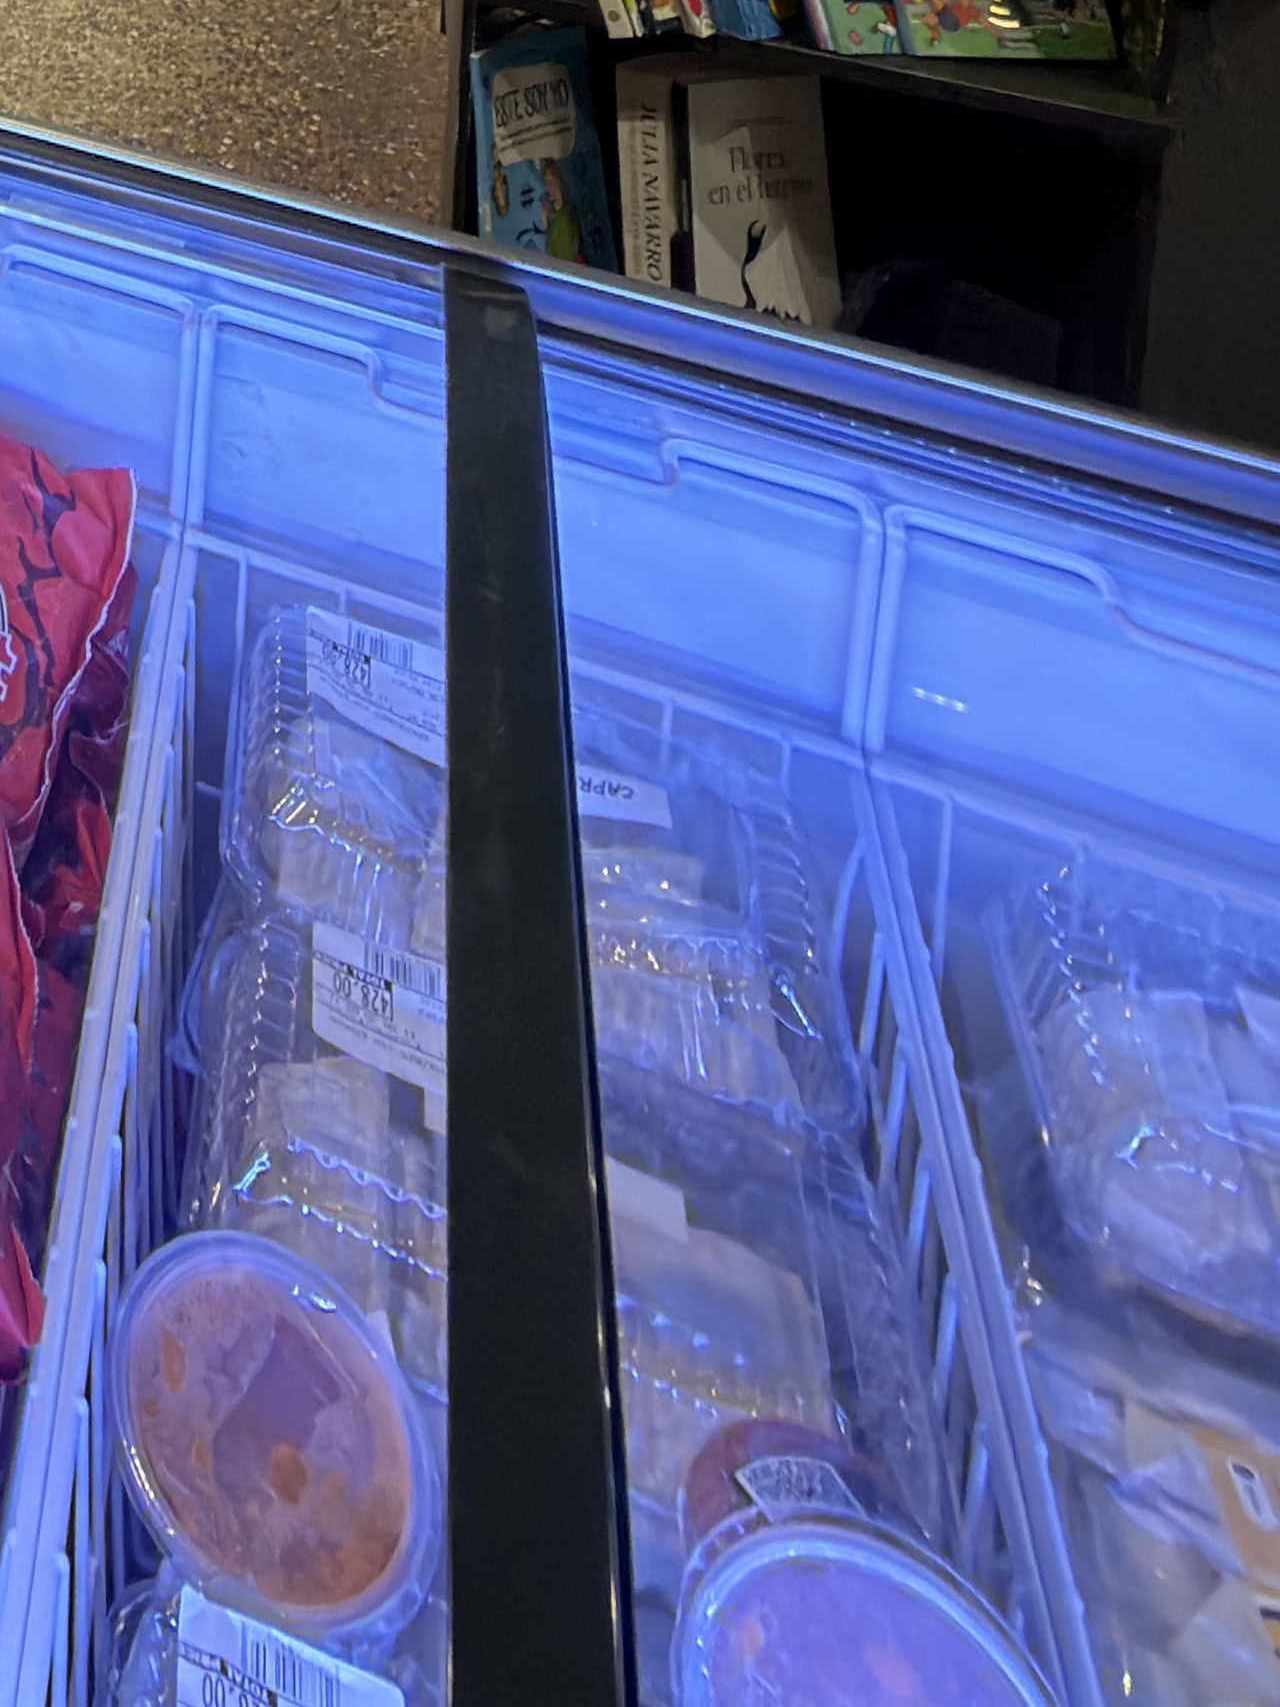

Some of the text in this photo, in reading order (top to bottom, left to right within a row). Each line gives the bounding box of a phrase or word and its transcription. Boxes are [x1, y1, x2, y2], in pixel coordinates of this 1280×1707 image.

[494, 79, 571, 127] ESTE SOY YO
[641, 102, 663, 282] JULIA NAVARRO
[708, 185, 730, 206] en
[579, 777, 634, 801] CAPR
[333, 969, 389, 1015] 428.00
